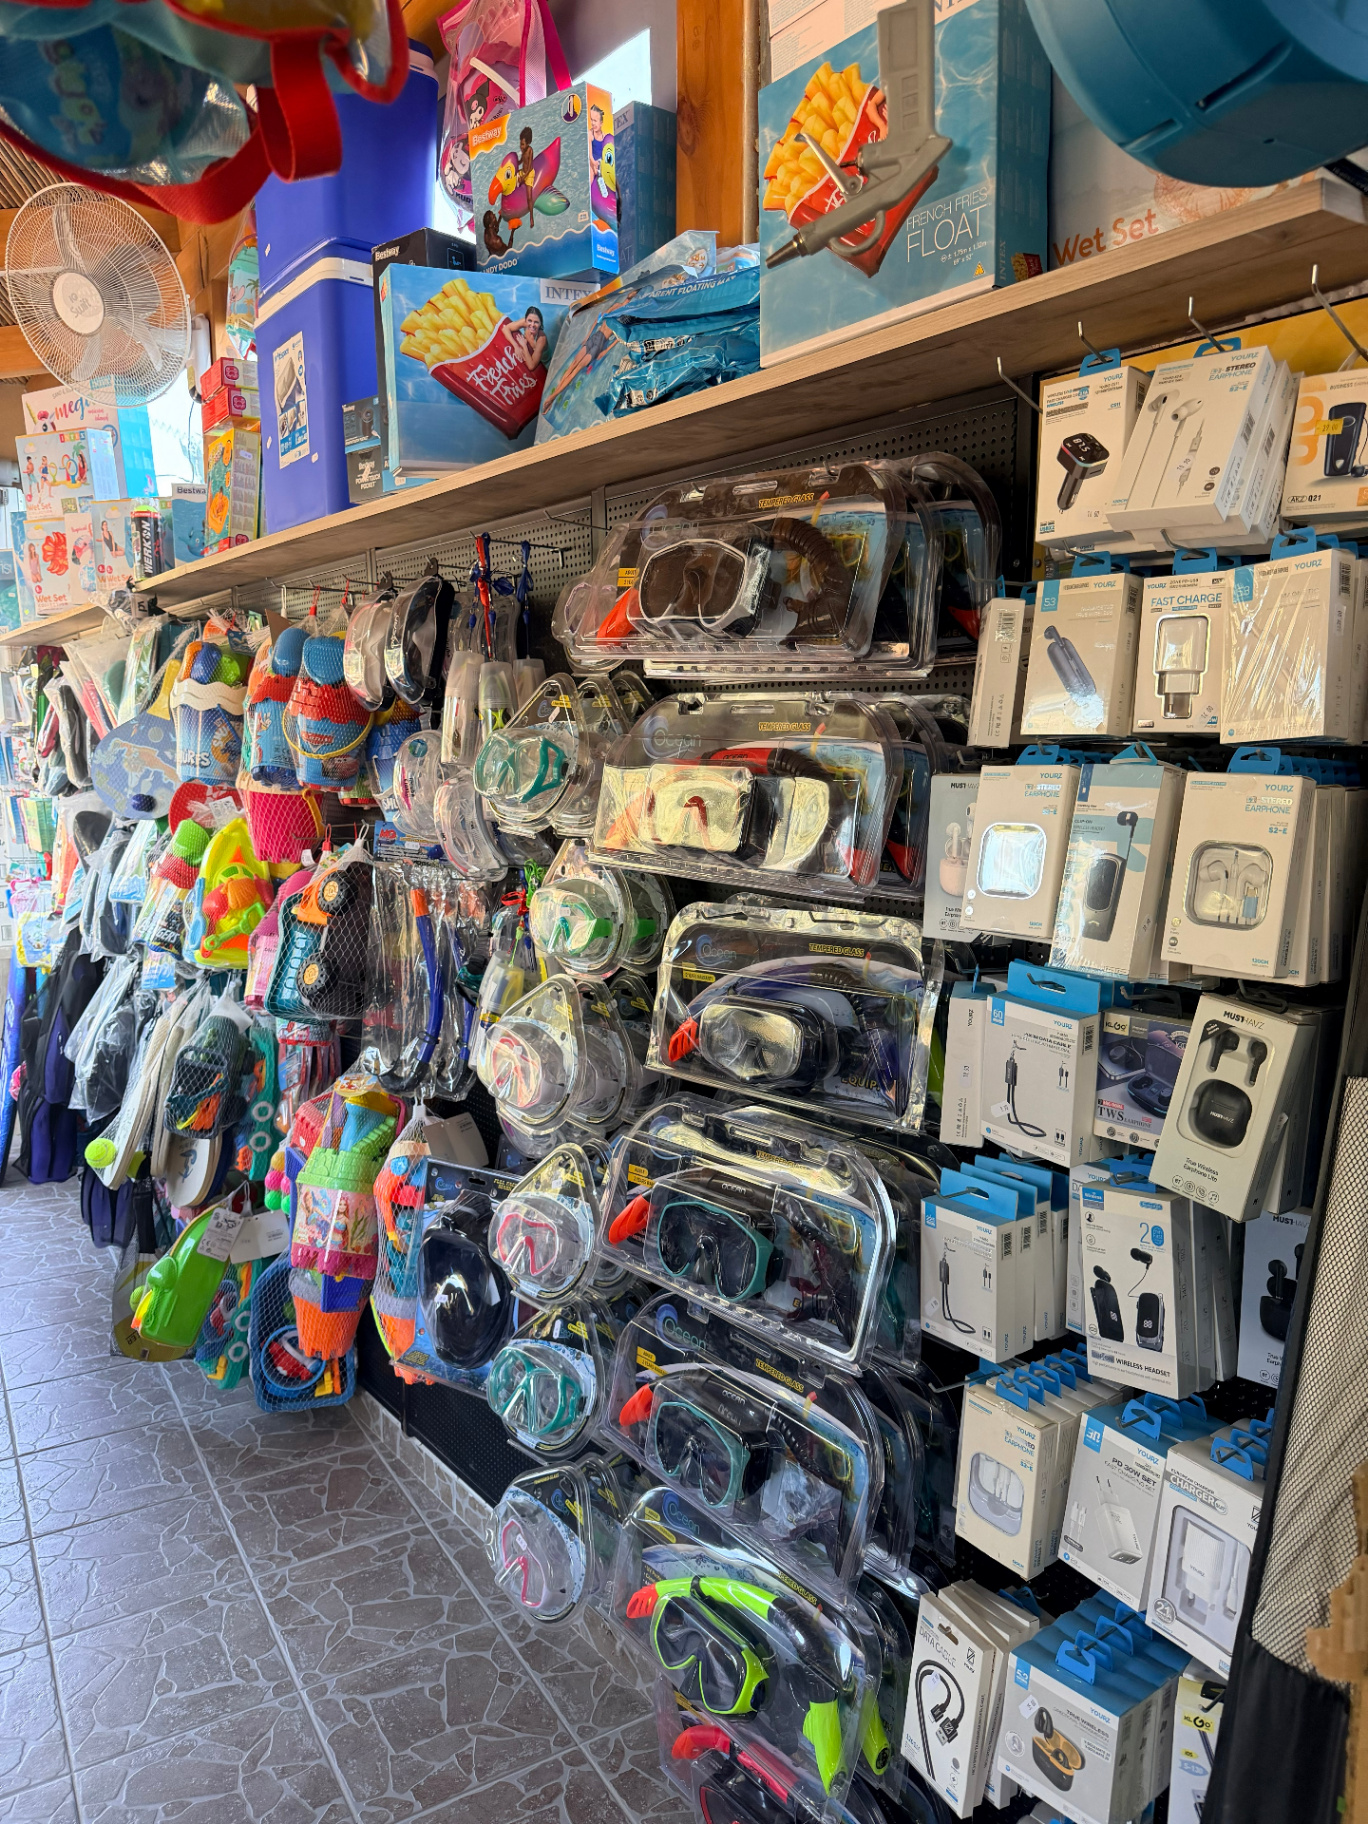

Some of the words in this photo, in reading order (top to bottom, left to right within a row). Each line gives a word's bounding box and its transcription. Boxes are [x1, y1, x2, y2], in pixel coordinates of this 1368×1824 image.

[472, 126, 502, 147] Bestway
[906, 201, 953, 231] FRENCH
[955, 186, 989, 212] FRIES
[907, 203, 988, 263] FLOAT
[1052, 228, 1107, 266] Wet
[1112, 208, 1160, 247] Set
[375, 245, 400, 262] Bestway
[597, 244, 615, 257] Bestway
[499, 257, 518, 272] DODO
[677, 280, 716, 296] FLOATING
[1231, 351, 1260, 362] YOURZ
[1208, 368, 1253, 381] EARPHONE
[1225, 361, 1257, 373] STEREO
[1104, 373, 1124, 383] YOURZ
[490, 372, 538, 406] Fries
[176, 486, 207, 496] Bestwa
[27, 503, 41, 511] Wet
[758, 496, 792, 508] TEMPERED
[793, 492, 815, 503] GLASS
[1295, 558, 1323, 571] YOURZ
[1093, 581, 1117, 589] YOURZ
[35, 595, 52, 604] Wet
[53, 594, 67, 602] Set
[1150, 595, 1176, 607] FAST
[1176, 592, 1223, 605] CHARGE
[758, 721, 790, 732] TEMPERED
[790, 722, 812, 732] GLASS
[654, 729, 701, 748] Ocean
[1040, 772, 1063, 780] YOURZ
[1024, 790, 1060, 798] EARPHONE
[1264, 783, 1294, 793] YOURZ
[1260, 796, 1294, 806] STEREO
[1244, 804, 1292, 815] EARPHONE
[1268, 826, 1288, 835] S2-E
[809, 942, 841, 955] TEMPERED
[842, 947, 865, 958] GLASS
[1053, 1019, 1073, 1030] YOURZ
[1098, 1106, 1124, 1122] TWS
[1182, 1163, 1207, 1179] Earphone
[1185, 1157, 1197, 1168] True
[1197, 1161, 1220, 1177] Wireless
[664, 1317, 707, 1350] Ocean
[755, 1358, 788, 1382] TEMPERED
[785, 1375, 805, 1393] GLASS
[1115, 1357, 1144, 1371] WIRELESS
[1144, 1365, 1171, 1378] HEADSET
[1016, 1425, 1037, 1441] YOURZ
[1004, 1436, 1035, 1457] EARPHONE
[1137, 1447, 1160, 1466] YOURZ
[1111, 1457, 1123, 1468] PD
[1123, 1464, 1141, 1478] 30W
[1141, 1474, 1157, 1487] SET
[1169, 1474, 1216, 1507] CHARGER
[669, 1502, 700, 1536] Ocean
[1189, 1564, 1206, 1578] YOURZ
[918, 1628, 935, 1648] DATA
[1089, 1707, 1111, 1724] YOURZ
